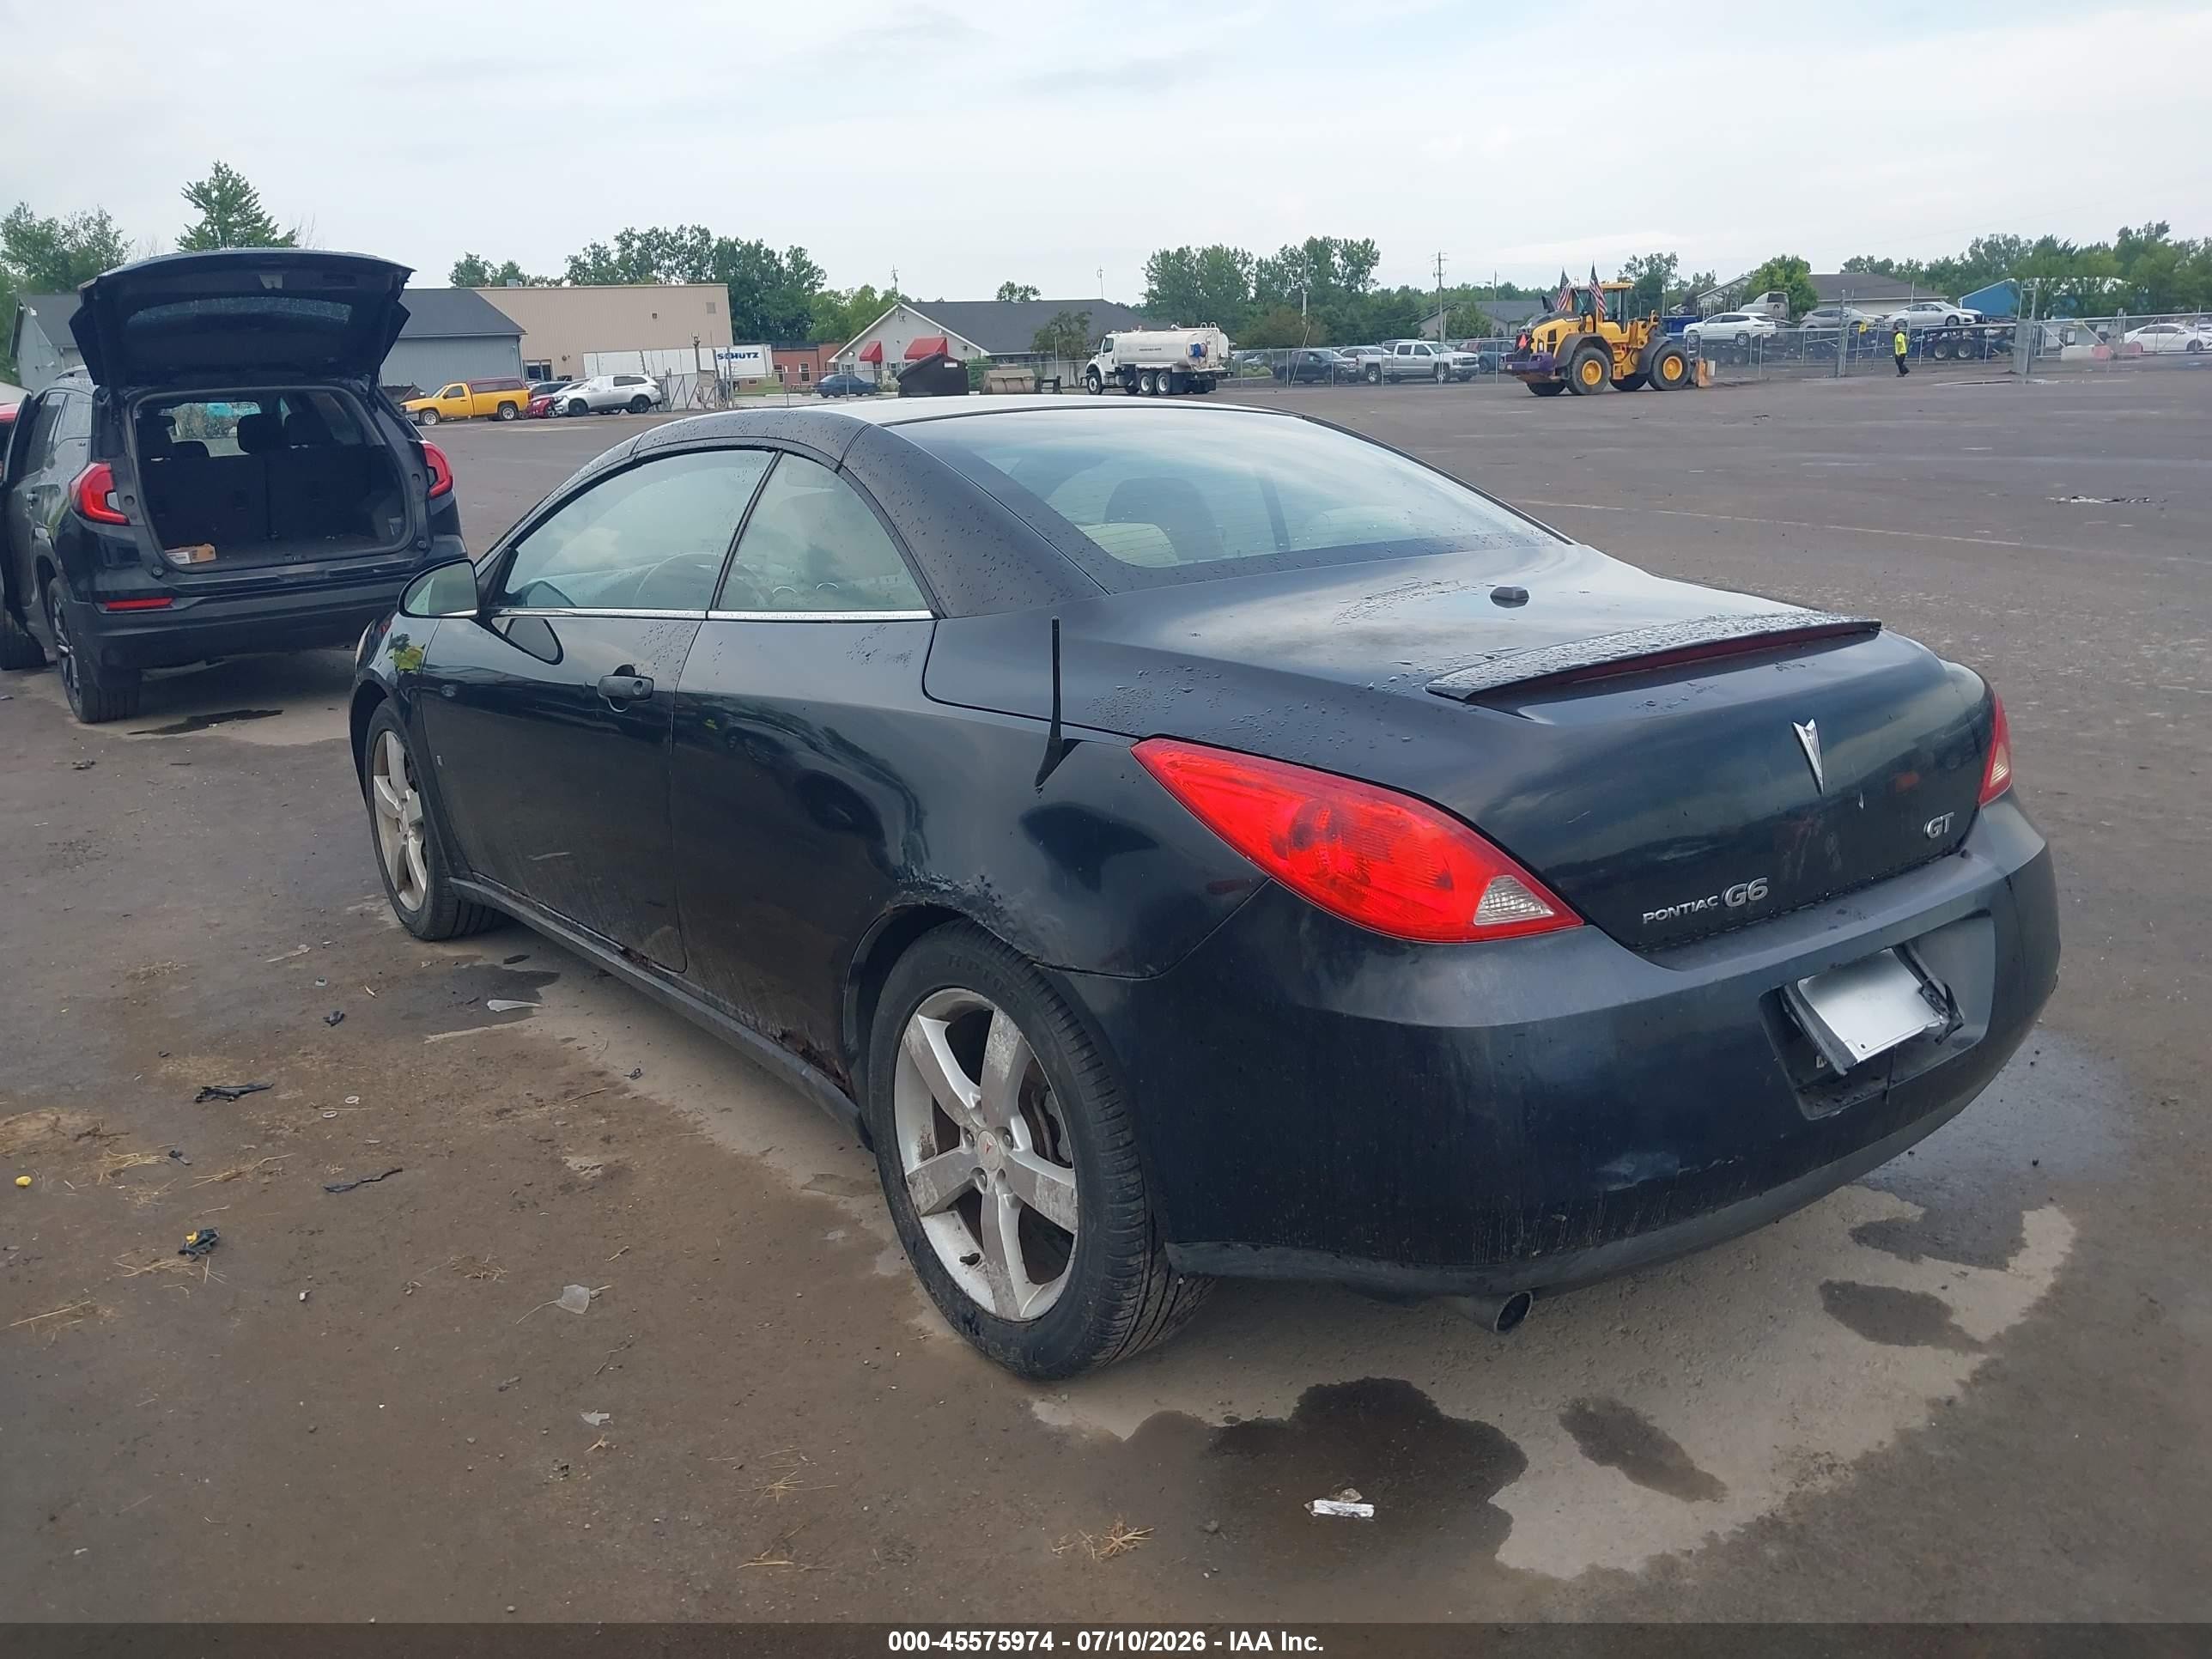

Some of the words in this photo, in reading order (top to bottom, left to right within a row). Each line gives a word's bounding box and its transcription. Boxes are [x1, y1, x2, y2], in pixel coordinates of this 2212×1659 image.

[1925, 811, 1954, 839] GT
[1643, 895, 1718, 925] PONTIAC
[1723, 878, 1769, 908] G6
